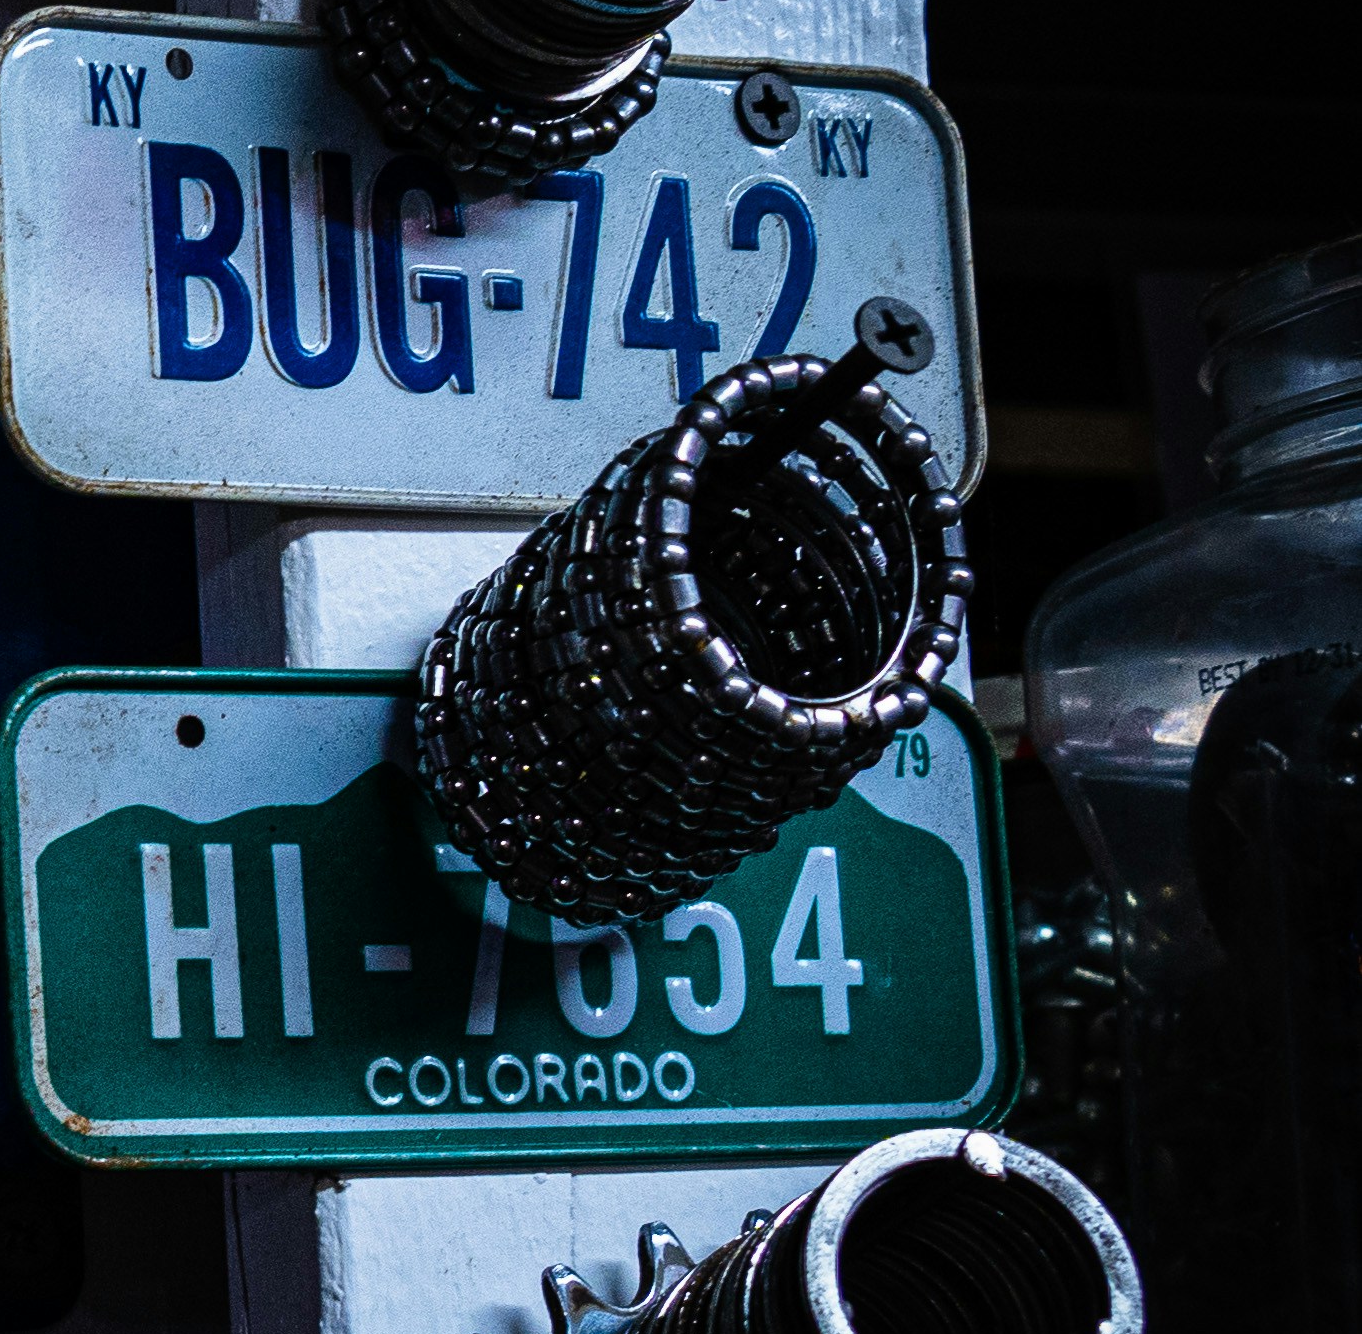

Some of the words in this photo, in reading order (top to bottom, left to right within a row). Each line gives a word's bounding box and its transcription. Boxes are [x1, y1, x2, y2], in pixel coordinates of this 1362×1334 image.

[88, 63, 147, 130] KY
[815, 116, 874, 180] KY
[145, 138, 819, 407] BUG-742
[1198, 660, 1246, 696] BEST
[892, 732, 932, 779] 79
[364, 1051, 696, 1108] COLORADO
